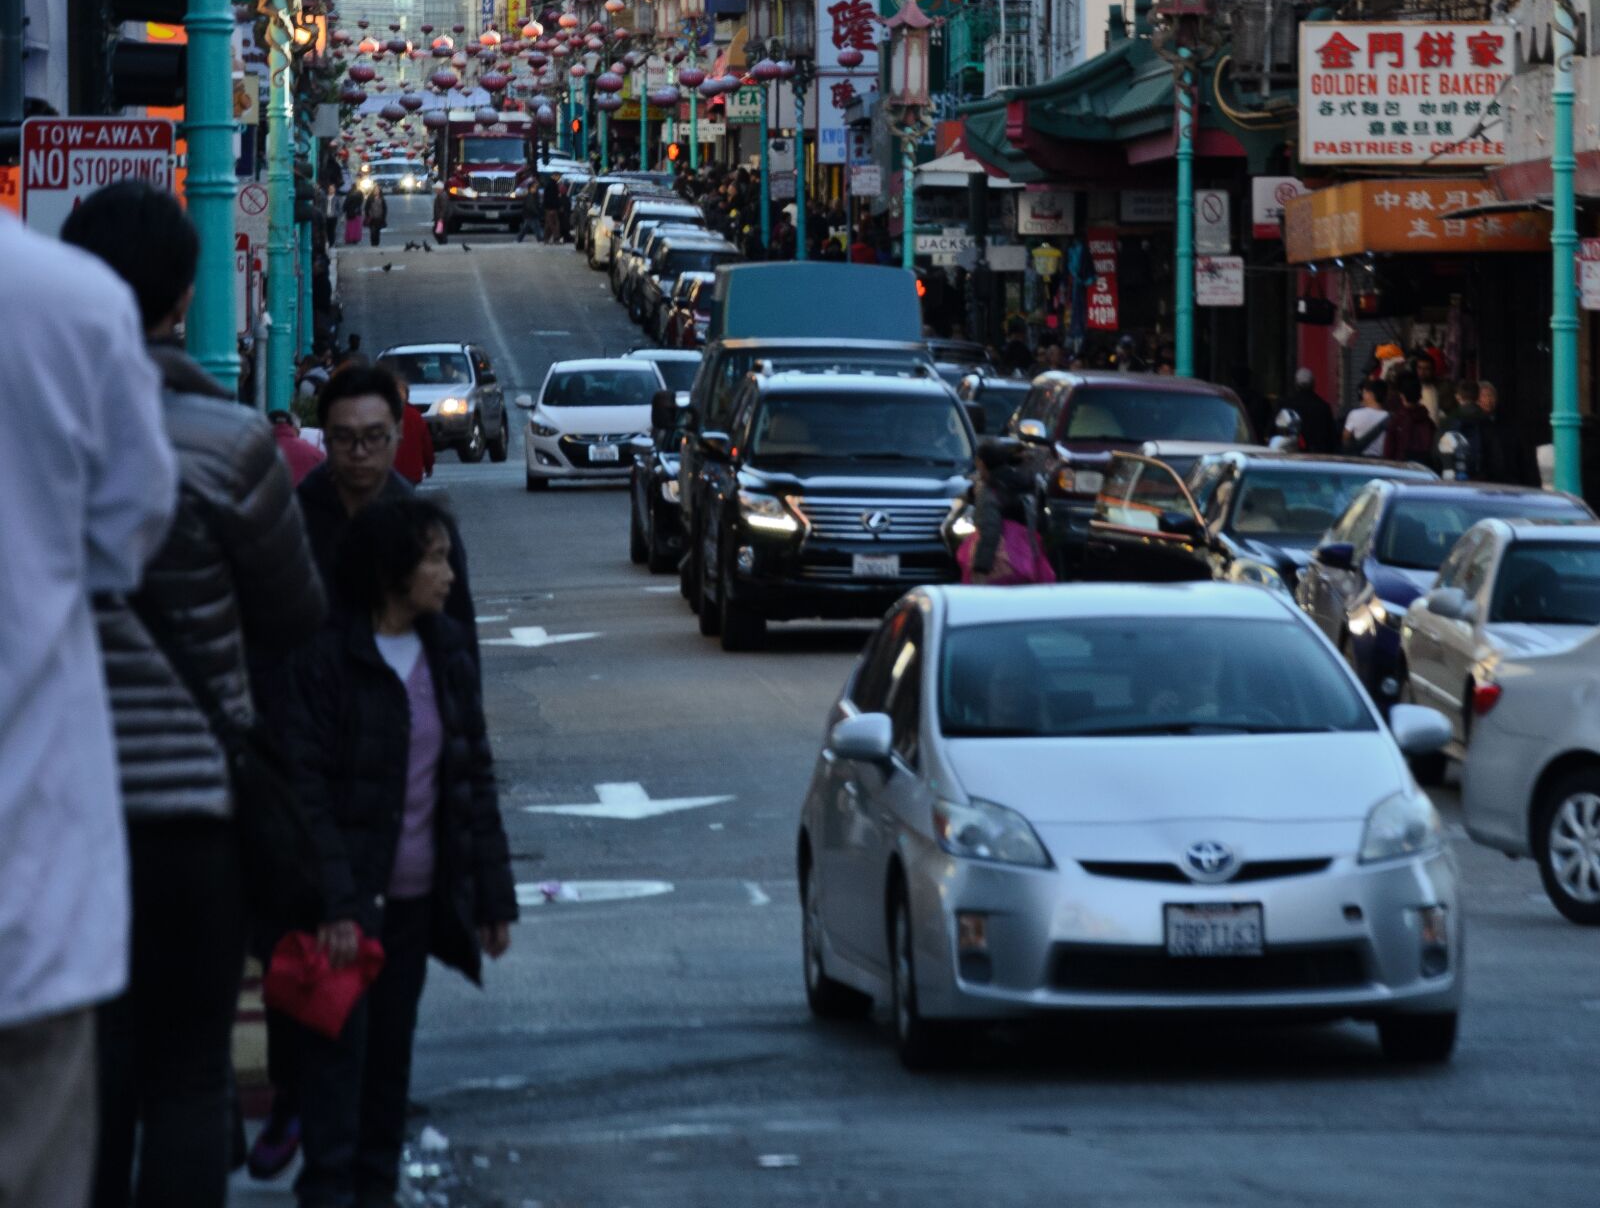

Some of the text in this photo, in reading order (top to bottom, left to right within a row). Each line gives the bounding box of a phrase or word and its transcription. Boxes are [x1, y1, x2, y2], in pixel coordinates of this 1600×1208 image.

[1315, 30, 1504, 70] 金門餅家
[1311, 73, 1379, 96] GOLDEN
[1387, 73, 1431, 96] GATE
[37, 124, 160, 146] TOW-AWAY
[1314, 141, 1505, 155] PASTRIES COFFEE
[27, 147, 65, 187] NO
[72, 155, 164, 186] STOPPING
[919, 238, 976, 250] JACKS
[1092, 294, 1112, 305] FOR
